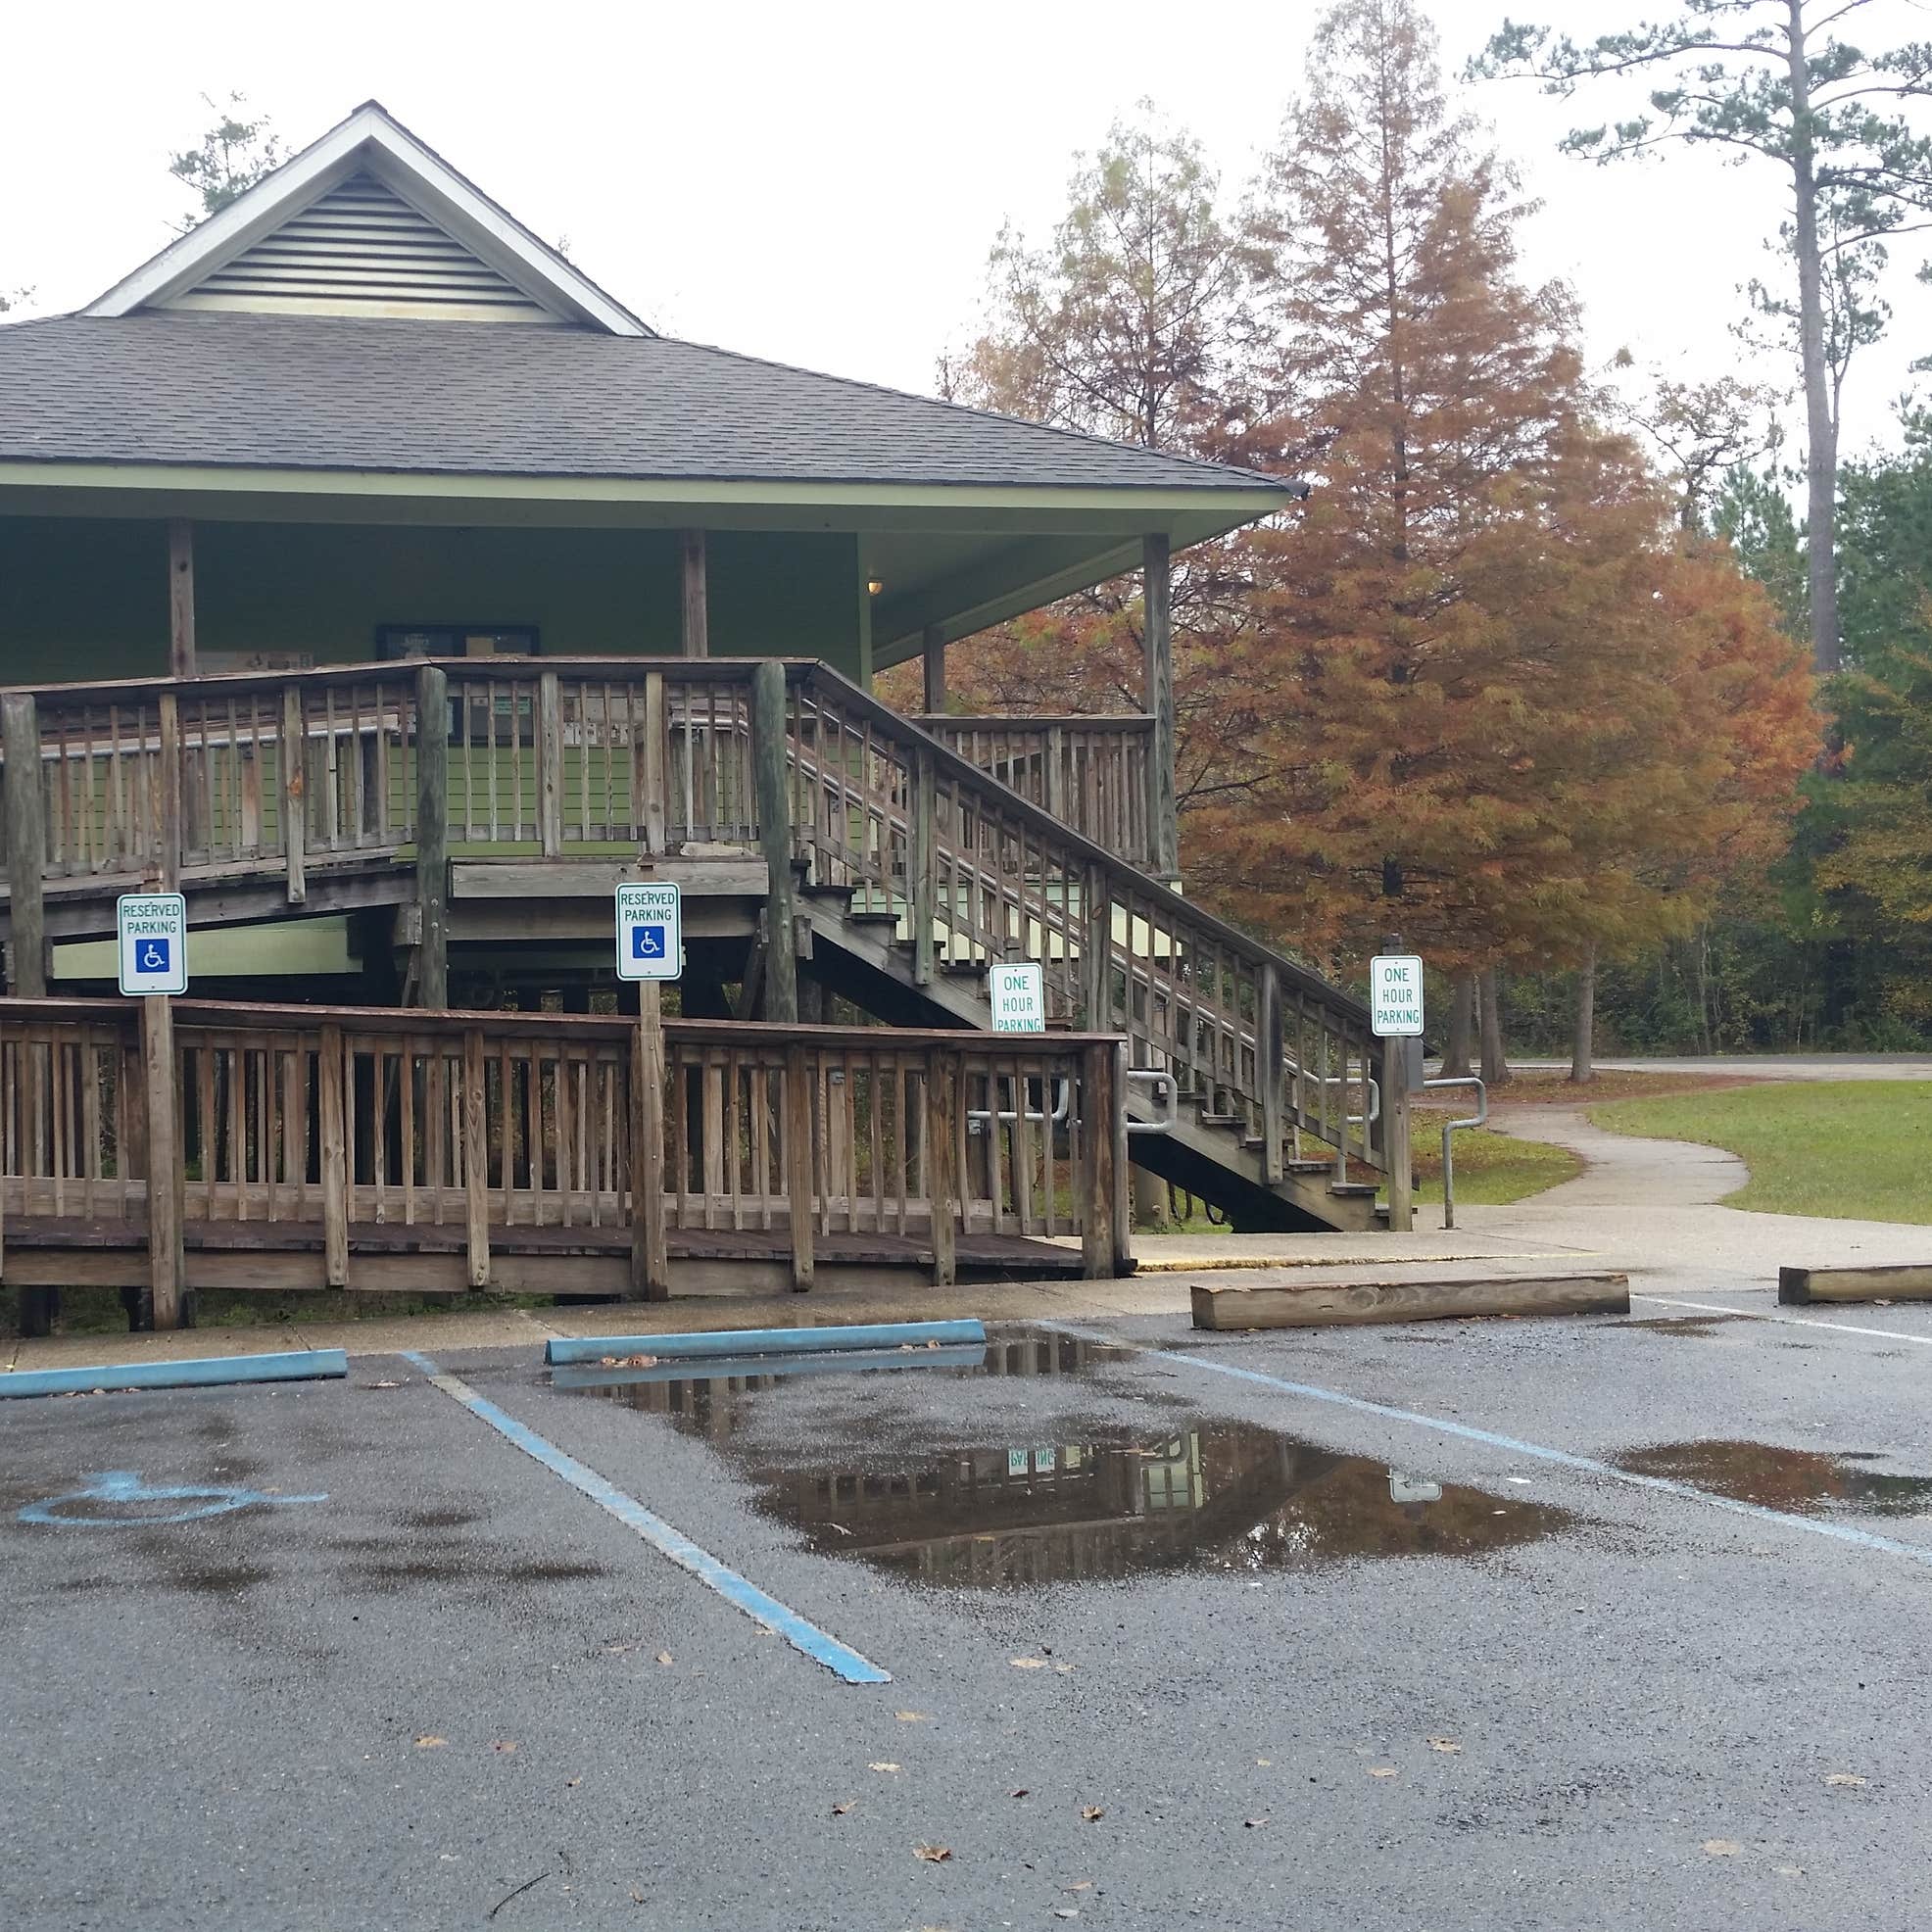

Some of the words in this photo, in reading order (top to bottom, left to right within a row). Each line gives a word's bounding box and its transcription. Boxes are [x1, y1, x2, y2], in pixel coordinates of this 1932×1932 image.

[621, 893, 675, 905] RESERVED
[123, 903, 180, 917] RESERVED
[625, 908, 672, 921] PARKING
[127, 920, 177, 934] PARKING
[1384, 967, 1410, 982] ONE
[1004, 975, 1030, 990] ONE
[1382, 989, 1413, 1003] HOUR
[1002, 996, 1034, 1012] HOUR
[1377, 1009, 1420, 1024] PARKING
[997, 1018, 1040, 1033] PARKING
